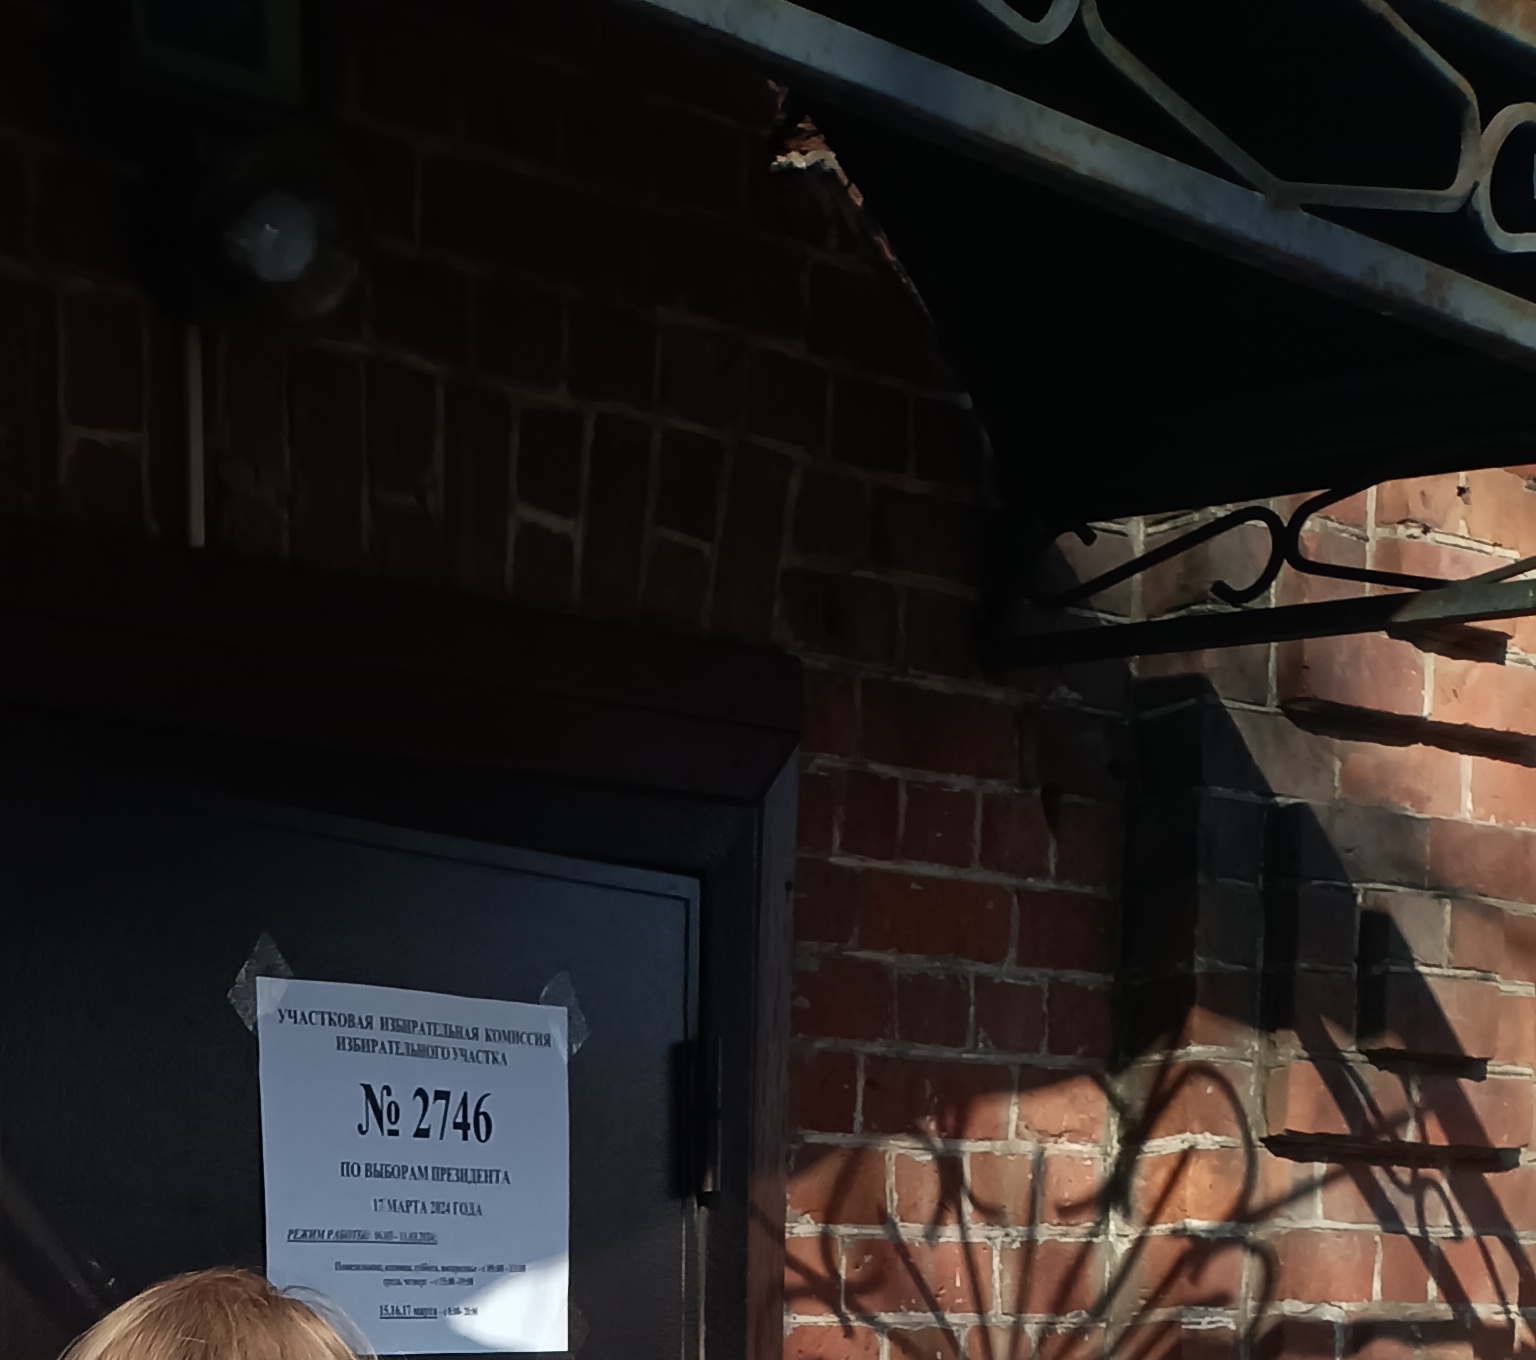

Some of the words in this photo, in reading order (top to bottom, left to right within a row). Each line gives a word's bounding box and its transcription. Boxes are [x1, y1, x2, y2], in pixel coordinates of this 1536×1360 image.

[278, 1008, 373, 1030] УЧАСТКОВАЯ
[380, 1016, 479, 1041] ИЗБИРАТЕЛЬНАЯ
[484, 1028, 552, 1048] КОМИССИЯ
[336, 1036, 451, 1061] ИЗБИРАТЕЛЬНОГО
[451, 1046, 508, 1066] УЧАСТКА
[357, 1083, 400, 1137] №
[412, 1087, 493, 1143] 2746
[340, 1161, 361, 1178] ПО
[364, 1163, 429, 1181] ВЫБОРАМ
[431, 1166, 511, 1185] ПРЕЗИДЕНТА
[387, 1199, 427, 1214] МАРТА
[452, 1201, 483, 1216] ГОДА
